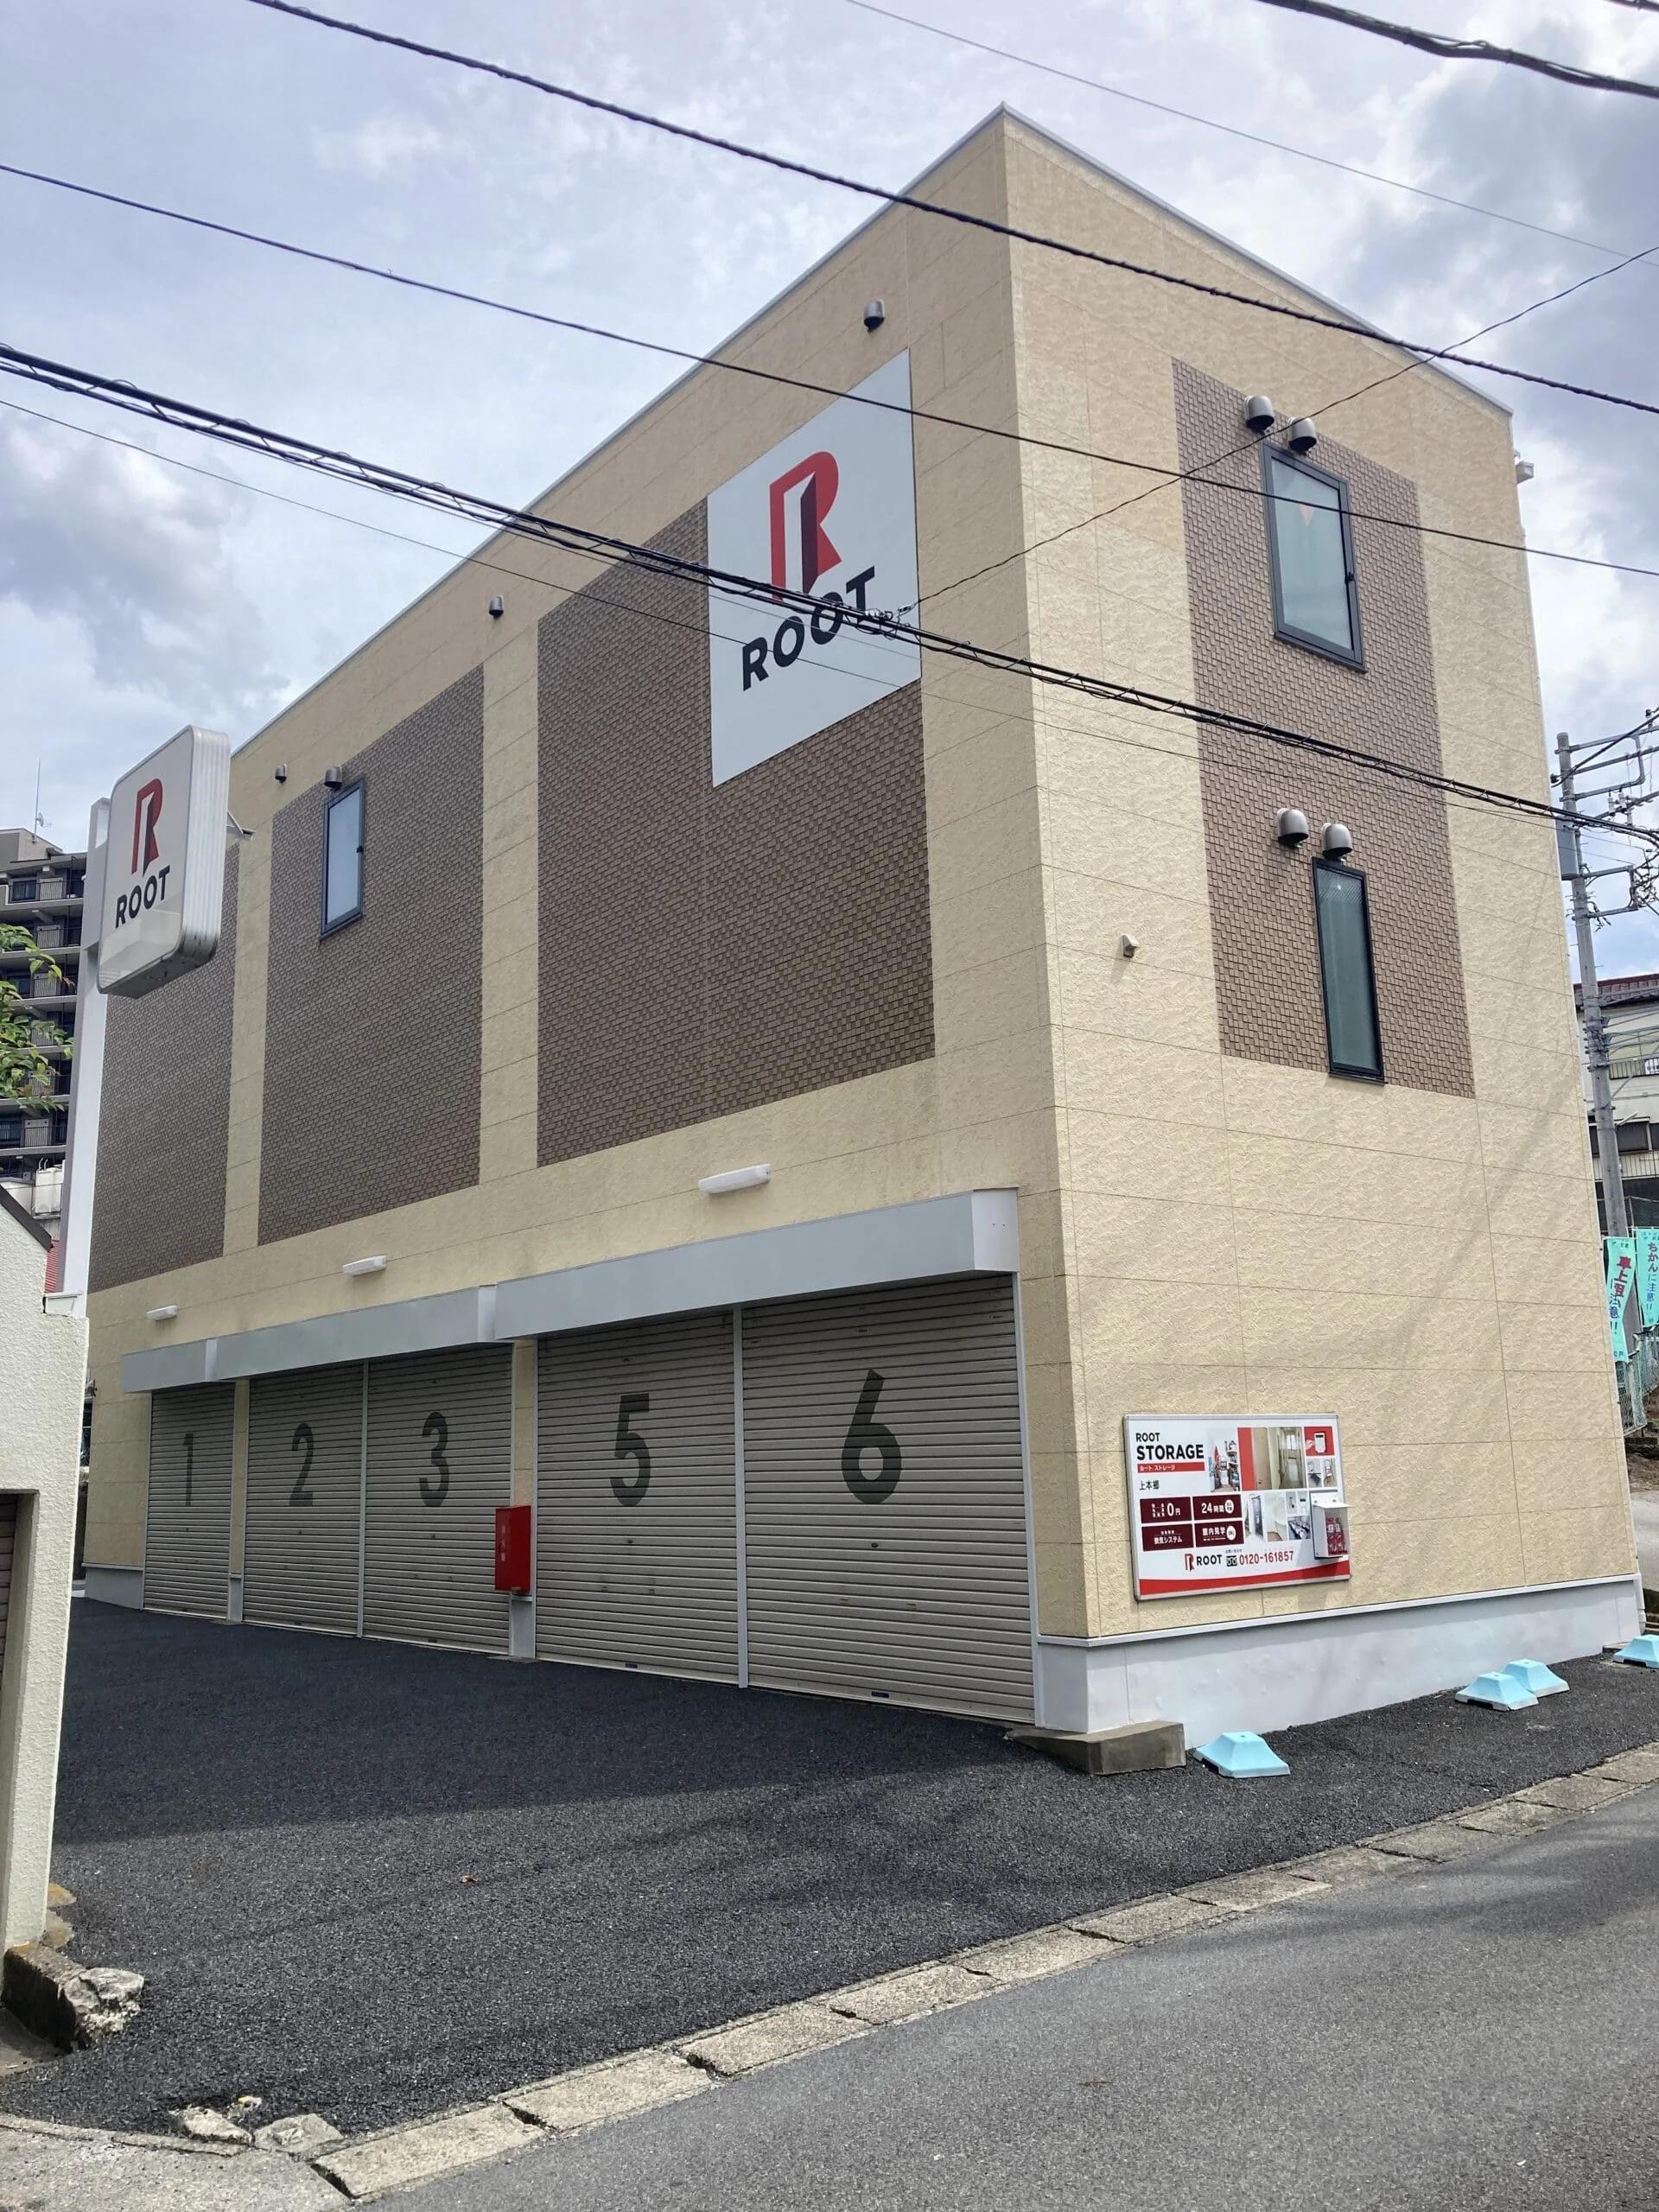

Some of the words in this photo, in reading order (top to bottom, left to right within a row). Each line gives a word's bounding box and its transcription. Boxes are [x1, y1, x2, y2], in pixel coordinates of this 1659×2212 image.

[742, 565, 875, 692] ROOT
[115, 864, 171, 930] ROOT
[183, 1433, 194, 1507] 1
[289, 1422, 315, 1507] 2
[418, 1411, 450, 1507] 3
[609, 1392, 652, 1507] 5
[841, 1369, 902, 1504] 6
[1135, 1432, 1160, 1442] ROOT
[1136, 1444, 1205, 1460] STORAGE
[1196, 1554, 1223, 1567] ROOT
[1239, 1550, 1294, 1566] 0120-161857
